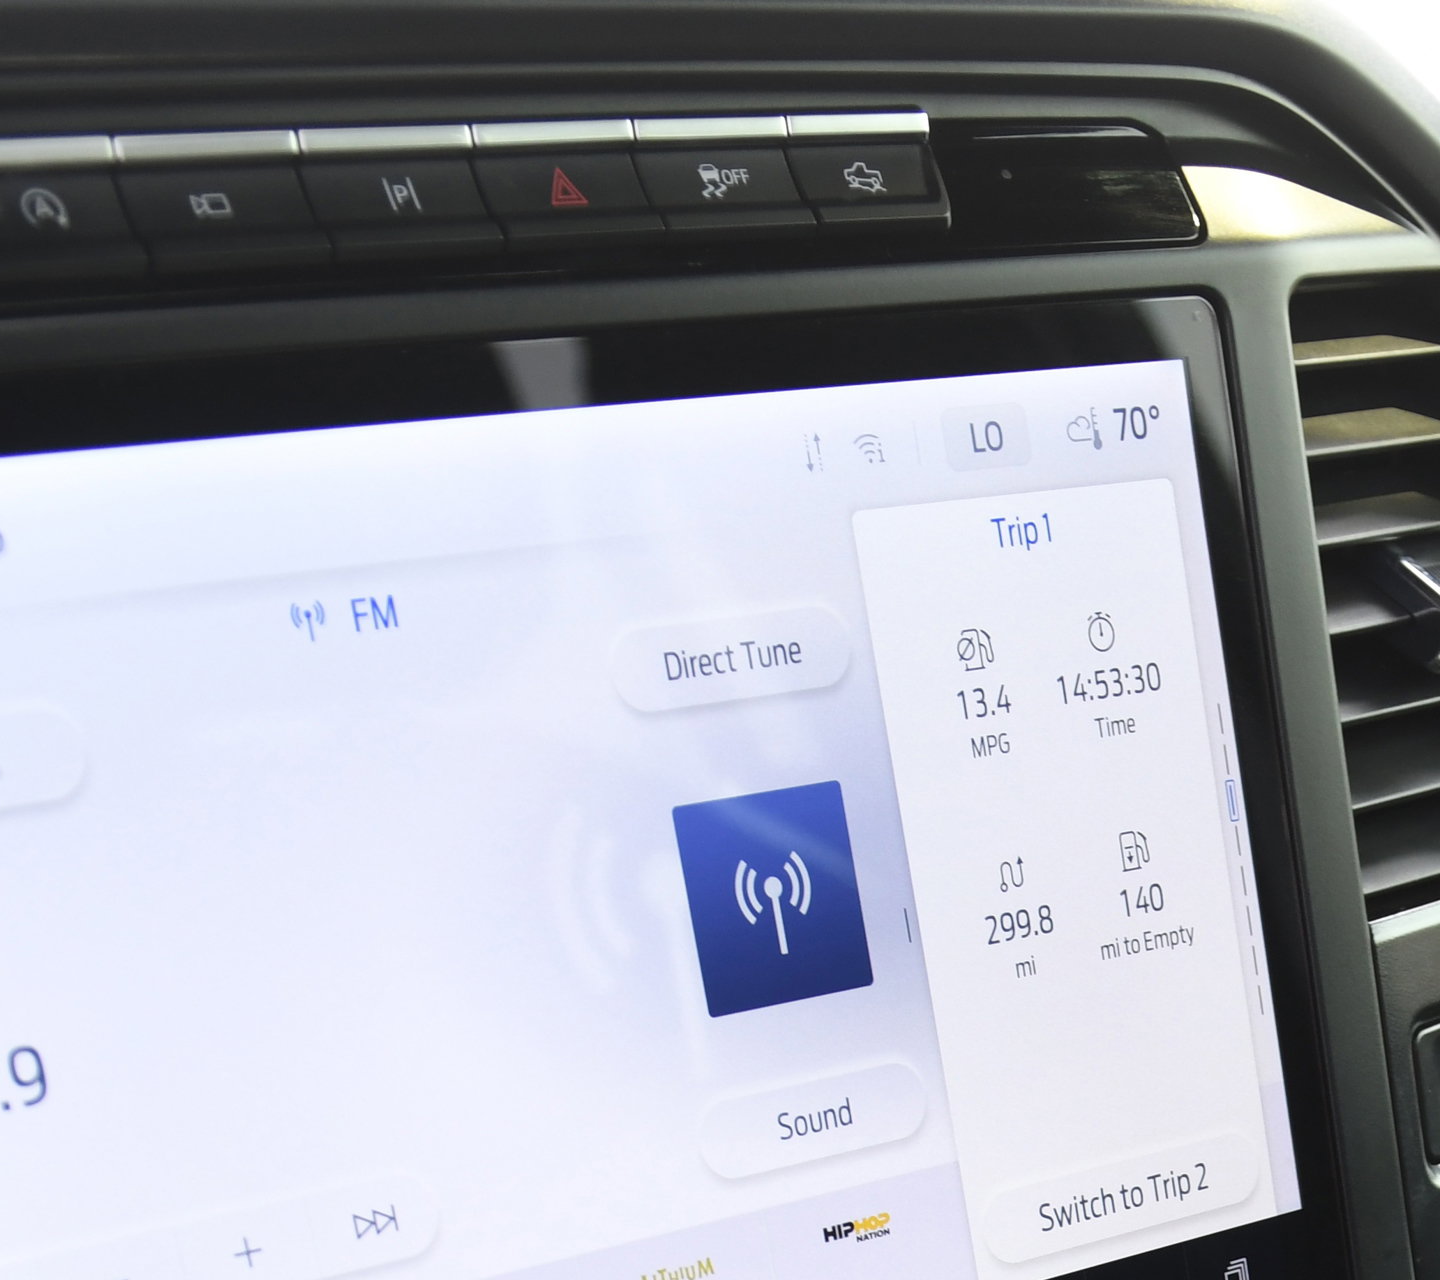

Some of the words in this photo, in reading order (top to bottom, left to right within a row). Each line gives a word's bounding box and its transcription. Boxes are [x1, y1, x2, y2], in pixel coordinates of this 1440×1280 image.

[721, 168, 749, 185] OFF
[971, 420, 1004, 455] LO
[1113, 405, 1160, 444] 70°
[351, 595, 400, 632] FM
[663, 646, 736, 684] Direct
[740, 637, 803, 671] Tune
[1056, 662, 1162, 706] 14:53:30
[957, 684, 1012, 721] 13.4
[970, 733, 1011, 759] MPG
[1094, 716, 1136, 740] Time
[1120, 883, 1165, 918] 140
[984, 904, 1055, 945] 299.8
[1099, 938, 1122, 961] mi
[1123, 934, 1141, 956] to
[1144, 925, 1195, 953] Empty
[1015, 955, 1037, 979] mi
[777, 1097, 855, 1142] Sound
[1039, 1188, 1116, 1232] Switch
[1119, 1182, 1145, 1211] to
[1148, 1170, 1191, 1201] Trip
[1192, 1162, 1210, 1191] 2
[856, 1227, 891, 1243] NATION
